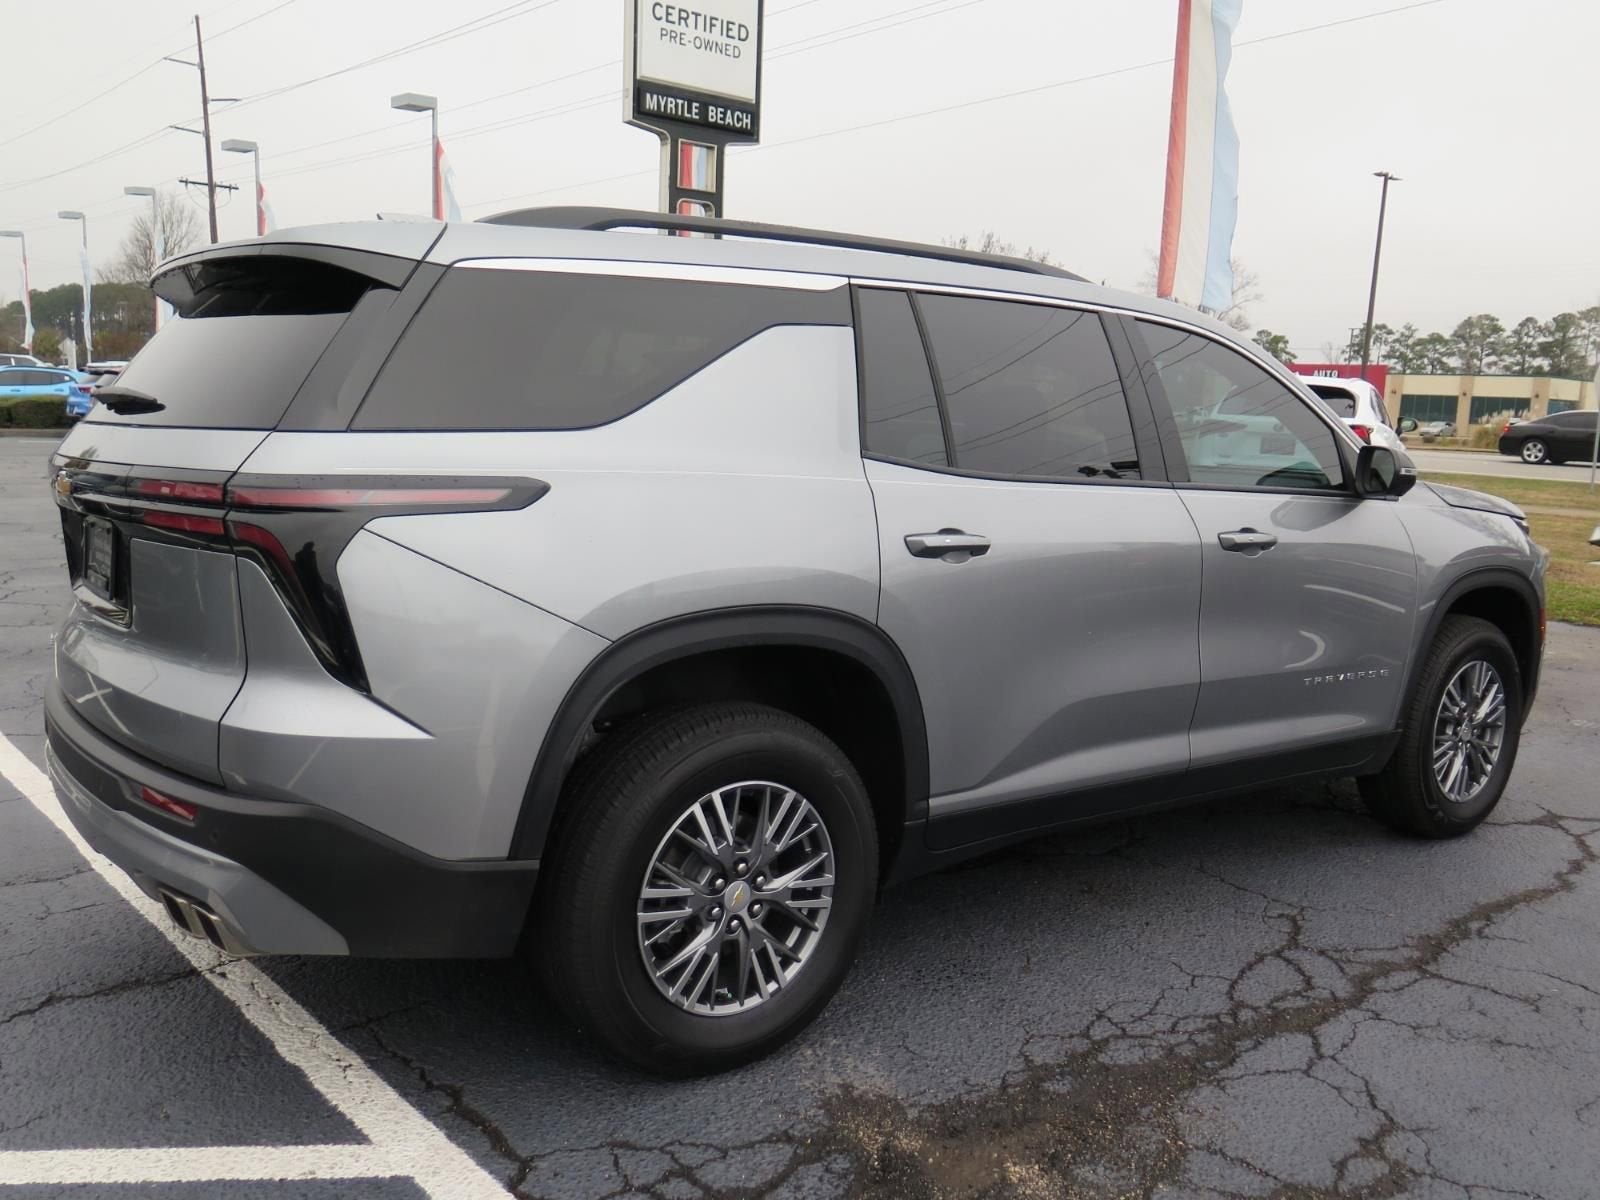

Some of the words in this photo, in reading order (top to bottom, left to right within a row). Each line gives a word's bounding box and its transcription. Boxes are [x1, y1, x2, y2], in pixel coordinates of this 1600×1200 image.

[652, 2, 749, 42] CERTIFIED
[660, 27, 741, 59] PRE-OWNED
[645, 93, 700, 119] MYRTLE
[708, 106, 751, 129] BEACH
[1313, 369, 1338, 378] AUTO
